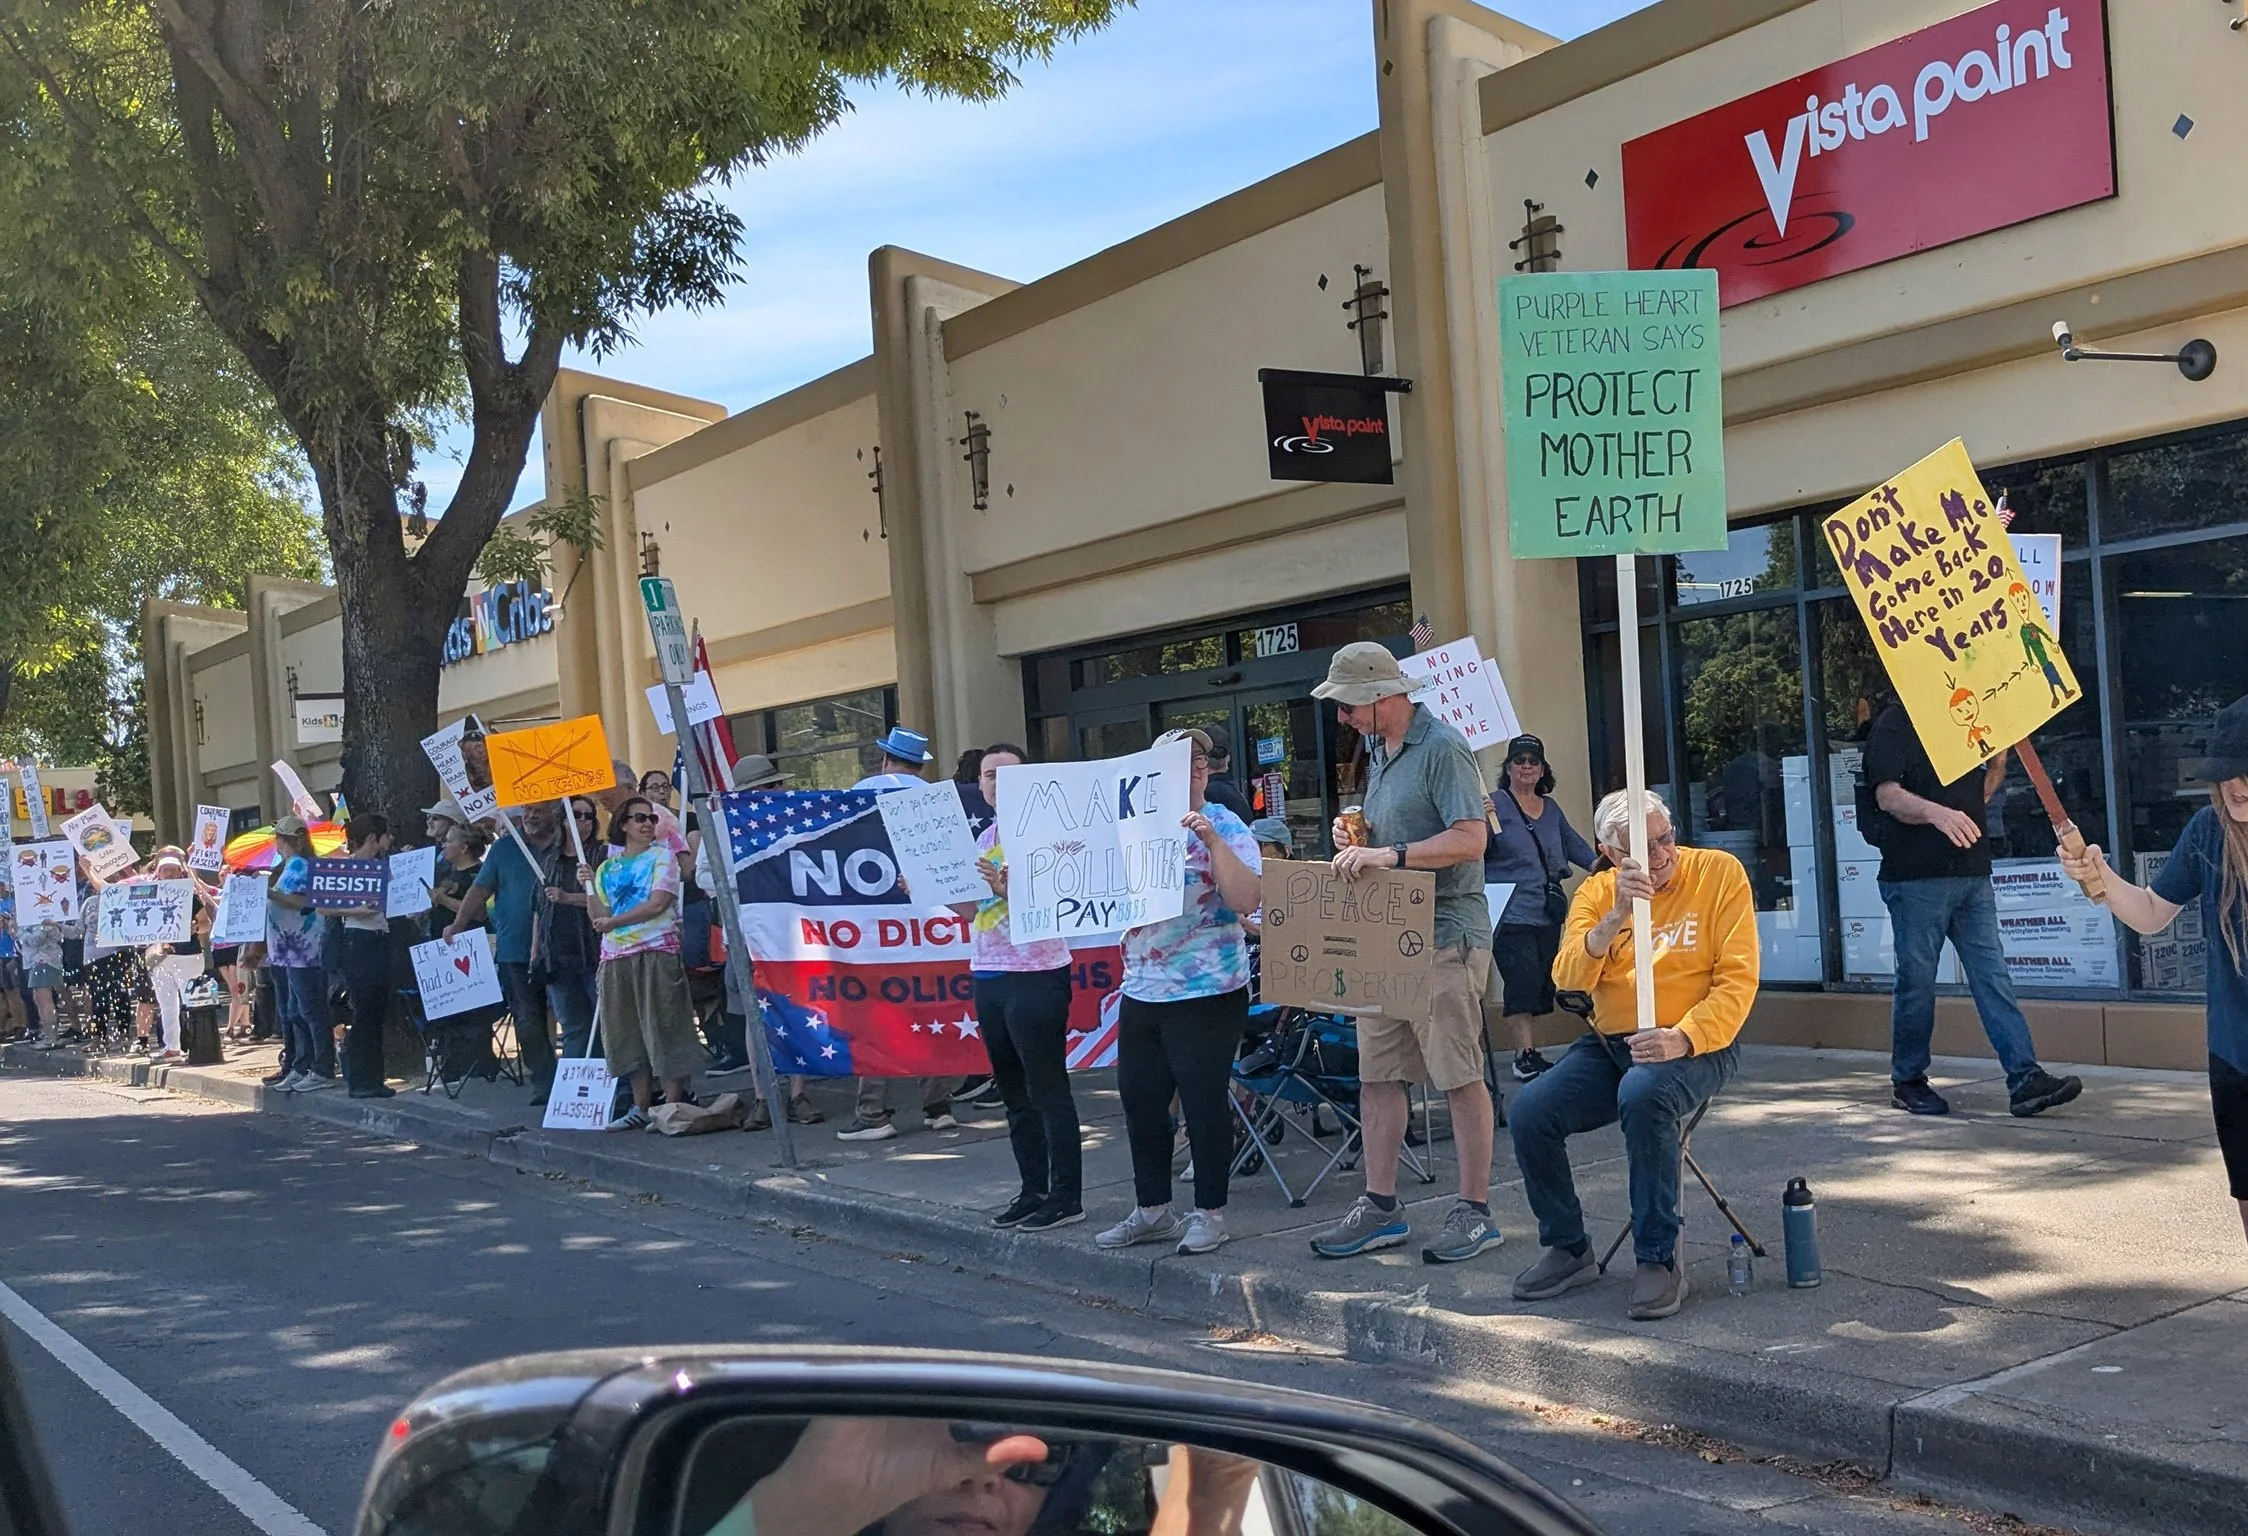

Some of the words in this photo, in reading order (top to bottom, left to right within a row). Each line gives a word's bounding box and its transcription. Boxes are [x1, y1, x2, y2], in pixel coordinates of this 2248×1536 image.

[1744, 94, 1907, 239] Vista
[1913, 7, 2072, 143] paint
[1516, 291, 1609, 319] PURPLE
[1625, 289, 1703, 316] HEART
[1520, 326, 1630, 357] VETERAN
[1643, 324, 1704, 352] SAYS
[1525, 369, 1700, 418] PROTECT
[1302, 414, 1346, 445] Vista
[1347, 417, 1384, 437] paint
[1540, 429, 1692, 479] MOTHER
[1555, 493, 1682, 537] EARTH
[1826, 484, 1905, 571] Don't
[1853, 521, 1946, 589] Make
[1940, 488, 1988, 533] Me
[2019, 547, 2042, 564] LL
[1869, 569, 1935, 621] Come
[1934, 524, 1988, 577] Back
[649, 582, 659, 608] 1
[1719, 578, 1751, 598] 1725
[2032, 579, 2055, 596] OW
[494, 579, 555, 645] Cribs
[1878, 605, 1940, 649] Here
[1938, 587, 1964, 609] in
[1968, 555, 2004, 594] 20
[1257, 625, 1296, 655] 1725
[1924, 597, 2008, 663] Years
[1426, 652, 1450, 669] NO
[1433, 661, 1478, 686] KING
[687, 701, 709, 714] INGS
[1440, 687, 1460, 705] AT
[302, 717, 323, 725] Kids
[1440, 703, 1474, 724] ANY
[1465, 720, 1489, 738] ME
[423, 738, 435, 748] NO
[428, 735, 458, 755] COURAGE
[432, 753, 444, 762] NO
[437, 755, 458, 769] HEART
[441, 768, 453, 777] NO
[446, 770, 466, 784] BRAIN
[513, 783, 543, 801] NO
[1016, 772, 1161, 837] MAKE
[463, 799, 483, 815] NO
[190, 857, 219, 869] FASCISM
[195, 848, 219, 859] FIGHT
[312, 876, 382, 893] RESIST!
[789, 847, 897, 898] NO
[1027, 837, 1188, 908] POLLUTERS
[1992, 873, 2039, 885] WEATHER
[2040, 872, 2059, 881] ALL
[1286, 869, 1406, 925] PEACE
[1993, 884, 2032, 892] olyethylene
[1056, 898, 1118, 931] PAY
[2000, 917, 2046, 928] WEATHER
[2047, 915, 2066, 925] ALL
[800, 917, 862, 948] NO
[878, 915, 972, 948] DICT
[1651, 921, 1697, 955] OVE
[436, 940, 449, 956] he
[2051, 956, 2071, 966] ALL
[417, 968, 442, 994] had
[445, 970, 454, 985] a
[808, 975, 867, 1002] NO
[553, 1101, 606, 1127] HEGSETH
